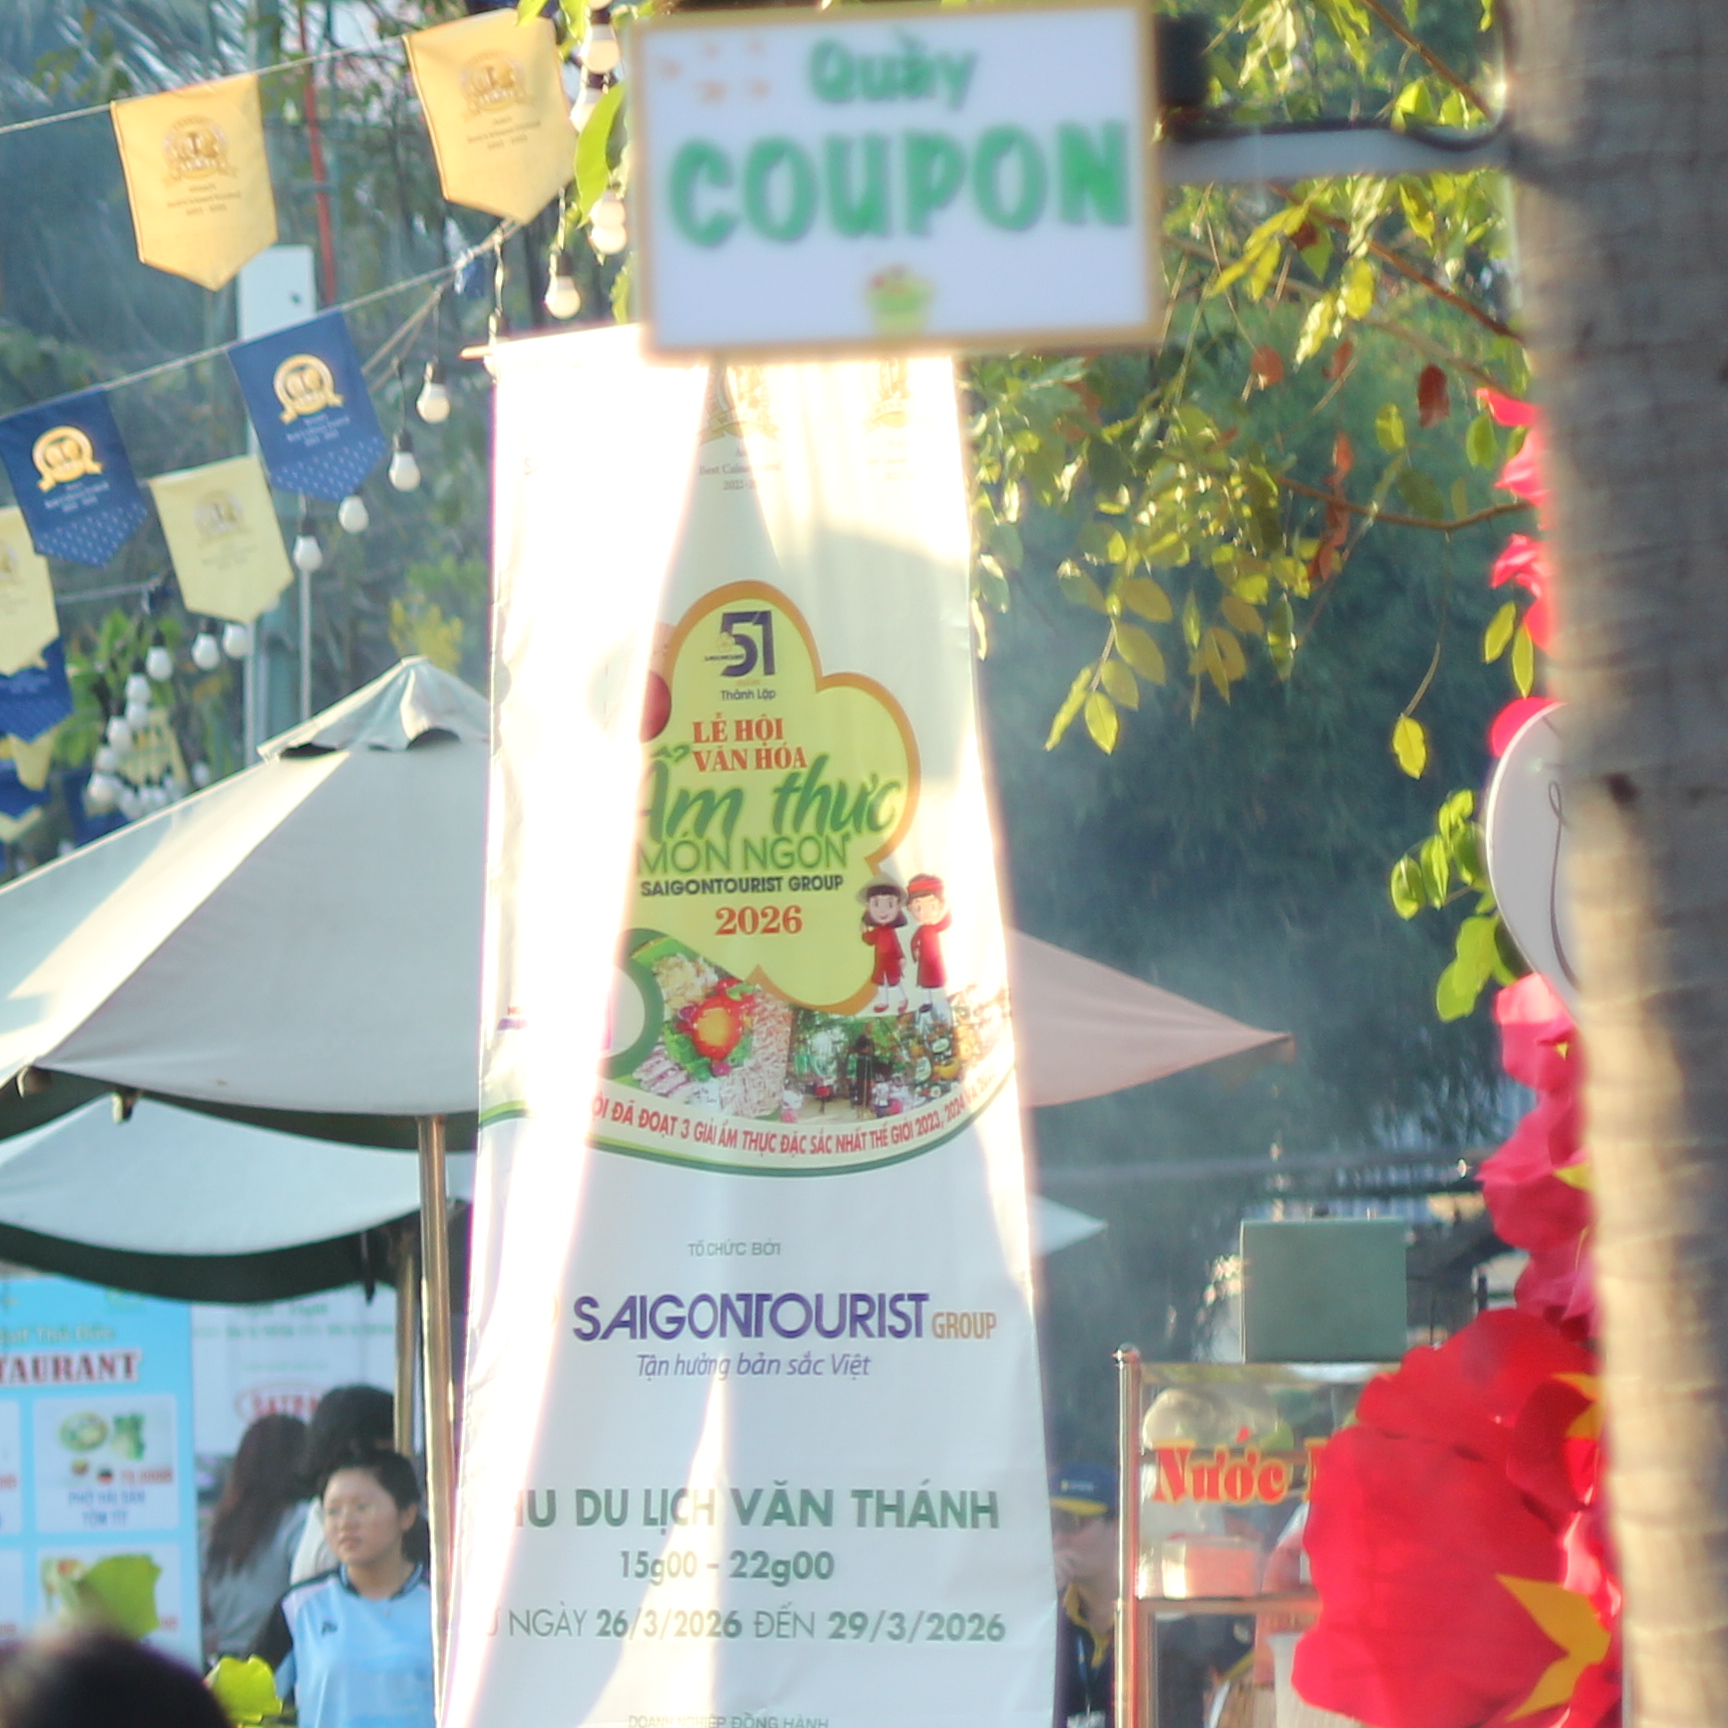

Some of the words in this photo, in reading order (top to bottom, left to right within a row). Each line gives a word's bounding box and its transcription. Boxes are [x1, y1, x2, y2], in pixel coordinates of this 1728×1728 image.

[806, 26, 979, 111] Quầy
[667, 122, 1132, 248] COUPON
[720, 610, 776, 678] 51
[692, 711, 728, 744] LỄ
[734, 713, 784, 745] HỘI
[692, 745, 748, 773] VĂN
[754, 743, 808, 770] HÓA
[772, 754, 902, 843] thực
[637, 829, 732, 875] MÓN
[743, 834, 848, 871] NGON
[640, 876, 784, 898] SAIGONTOURIST
[789, 873, 845, 892] GROUP
[715, 904, 804, 935] 2026
[638, 1108, 678, 1139] ĐOẠT
[680, 1118, 690, 1140] 3
[780, 1130, 807, 1158] ĐẶC
[810, 1127, 833, 1154] SẮC
[836, 1127, 867, 1153] NHẤT
[573, 1291, 930, 1342] SAIGONTOURIST
[931, 1311, 998, 1341] GROUP
[636, 1352, 670, 1381] Tận
[673, 1352, 731, 1381] hưởng
[736, 1351, 782, 1376] bản
[786, 1351, 825, 1376] sắc
[830, 1352, 872, 1381] Việt
[1153, 1424, 1290, 1506] Nước
[575, 1488, 629, 1528] DU
[643, 1488, 716, 1536] LỊCH
[730, 1479, 834, 1528] VĂN
[851, 1478, 1000, 1529] THÁNH
[620, 1550, 699, 1587] 15g00
[729, 1550, 835, 1588] 22g00
[508, 1600, 588, 1638] NGÀY
[595, 1606, 743, 1641] 26/3/2026
[753, 1601, 816, 1639] ĐẾN
[828, 1608, 1006, 1644] 29/3/2026
